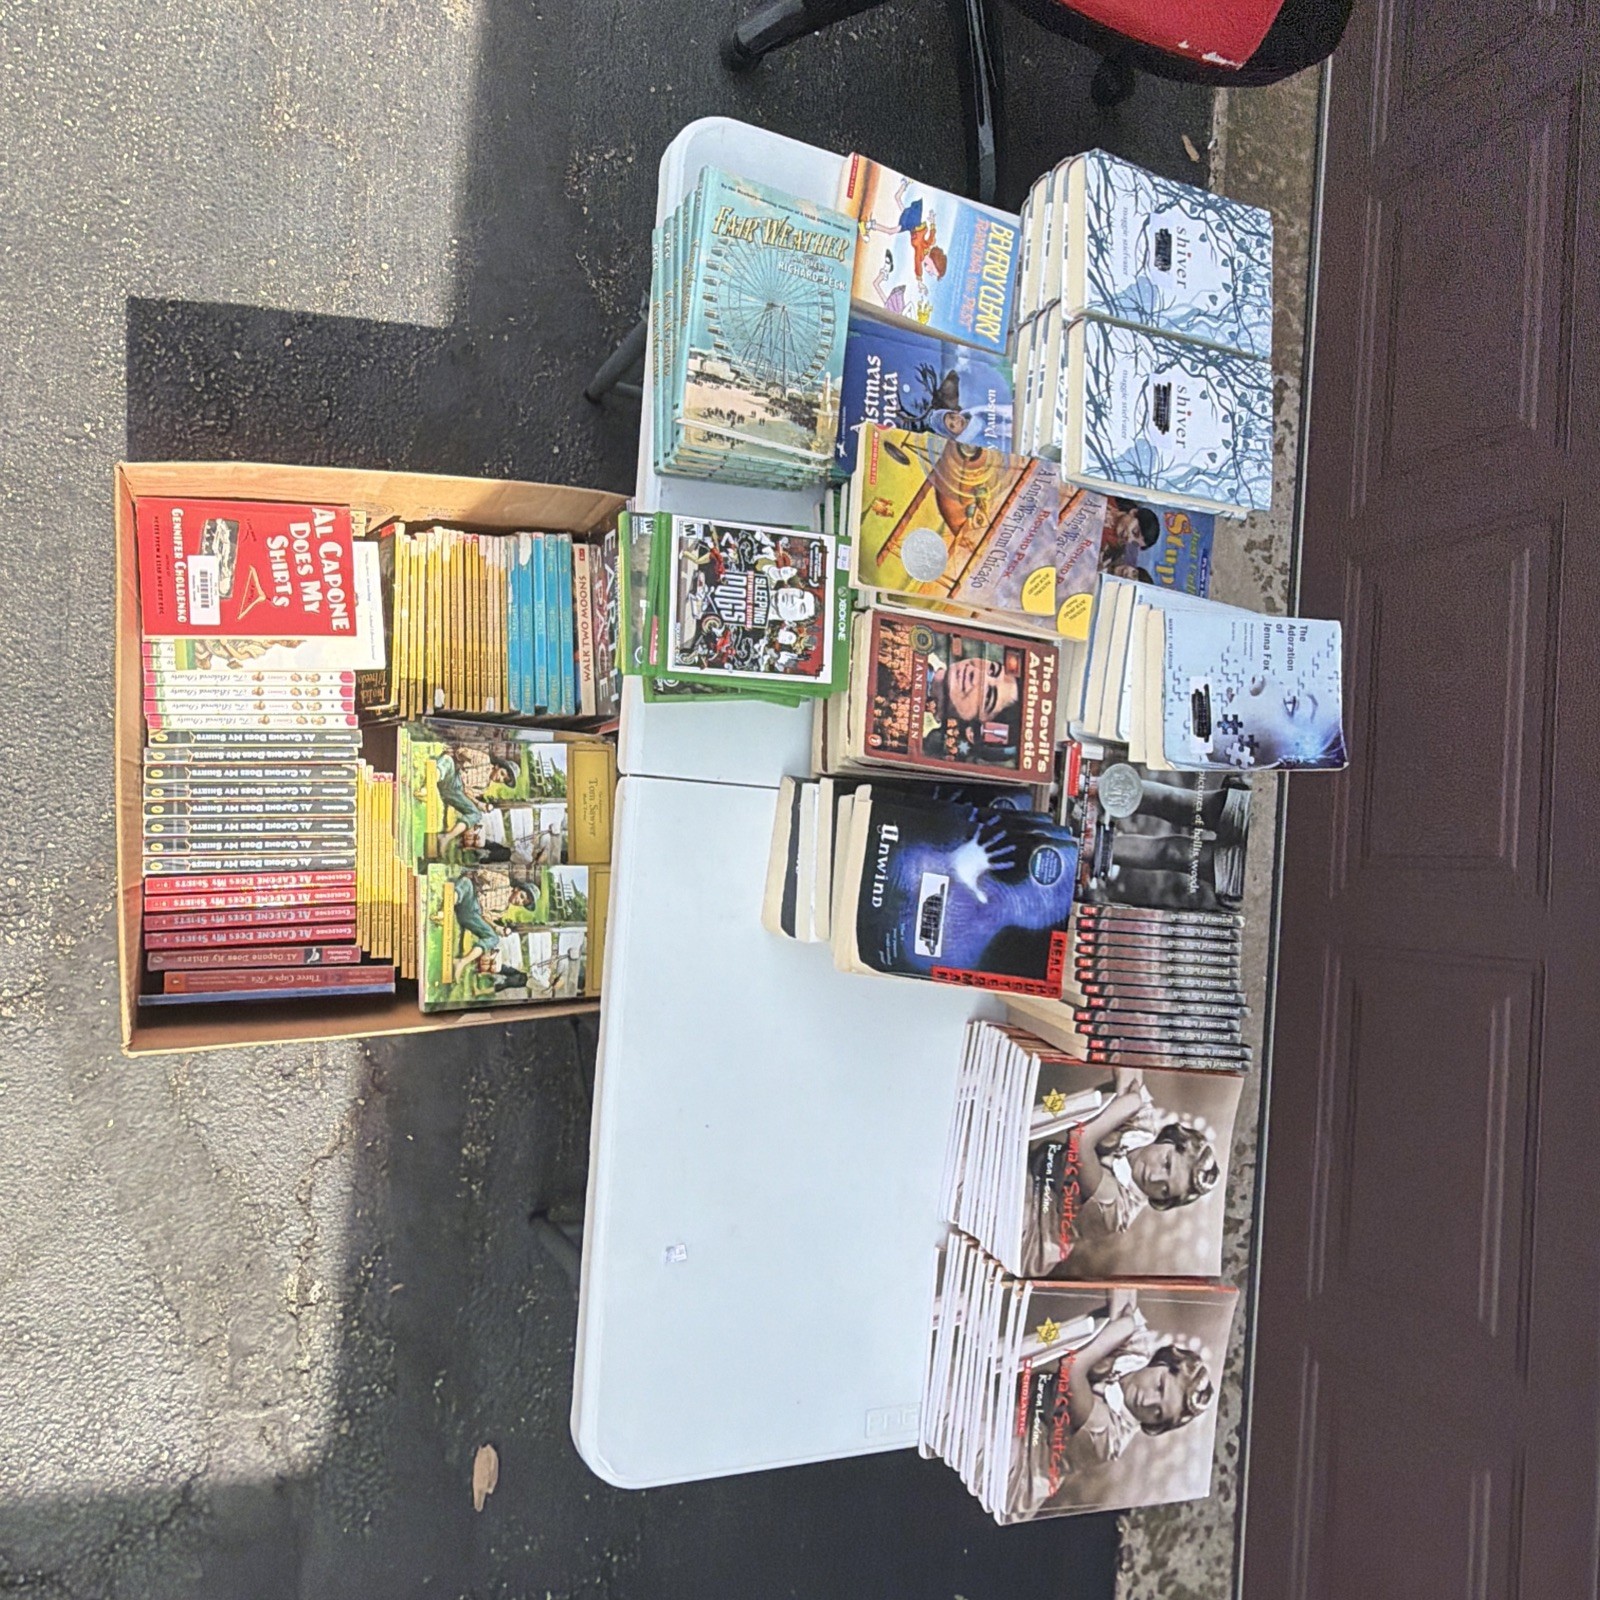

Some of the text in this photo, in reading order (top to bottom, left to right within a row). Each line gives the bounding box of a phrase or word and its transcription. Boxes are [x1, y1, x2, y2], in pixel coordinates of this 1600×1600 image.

[1121, 206, 1131, 237] maggie
[663, 232, 672, 260] PECK
[1175, 225, 1192, 290] shiver
[778, 261, 820, 284] RICHARD
[975, 221, 1015, 344] BEVERLY CLEARY
[860, 354, 880, 423] istmas
[1119, 369, 1130, 400] maggie
[883, 371, 898, 428] onata
[1174, 384, 1192, 449] shiver
[1087, 499, 1102, 509] A
[684, 523, 698, 537] M
[968, 468, 1056, 590] A Long Way from Chicago
[1019, 510, 1052, 551] RICHARD
[1065, 508, 1091, 532] Long
[1059, 540, 1094, 581] RICHARD
[1156, 512, 1192, 585] Stup
[171, 508, 187, 623] GENNIFER CHOLDENKO
[265, 535, 293, 608] SHIRTS
[288, 522, 324, 614] DOES MY
[311, 507, 351, 632] AL CAPONE
[1002, 551, 1026, 580] PECK
[713, 571, 748, 624] DOGS
[753, 577, 768, 625] SLEEPING
[578, 574, 592, 682] WALK TWO MOONS
[838, 598, 848, 642] XBOX ONE
[1276, 624, 1285, 634] of
[1299, 625, 1308, 643] The
[1263, 622, 1273, 671] Jenna Fox
[1287, 623, 1296, 672] Adoration
[911, 658, 925, 740] JANE YOLEN
[1022, 651, 1041, 770] Arithmetic
[1037, 654, 1055, 773] The Devil's
[228, 734, 242, 742] MY
[303, 733, 315, 742] AL
[224, 804, 238, 812] MY
[300, 803, 312, 812] AL
[588, 778, 599, 837] Tom Sawyer
[224, 841, 238, 850] MY
[300, 841, 312, 850] AL
[1188, 770, 1207, 894] pictures of hollis woods
[223, 859, 238, 868] MY
[299, 858, 311, 866] AL
[175, 880, 208, 889] SHIRTS
[212, 879, 226, 889] MY
[228, 878, 253, 888] DOES
[257, 877, 295, 887] CAPONE
[296, 875, 312, 886] AL
[174, 891, 350, 908] CHOLDENKO AL CAPONE DOES MY SHIRTS
[212, 933, 226, 943] MY
[229, 931, 253, 942] DOES
[257, 929, 295, 941] CAPONE
[296, 928, 312, 940] AL
[178, 955, 209, 964] Shirts
[212, 954, 225, 963] My
[228, 954, 249, 964] Does
[252, 953, 283, 963] Capone
[1049, 938, 1064, 975] NEAL
[252, 976, 264, 984] Tea
[275, 974, 294, 984] Cups
[297, 974, 321, 984] Three
[1042, 1144, 1058, 1214] Karen Levine
[1018, 1368, 1031, 1434] SCHOLASTIC
[1031, 1373, 1048, 1447] Karen Levine
